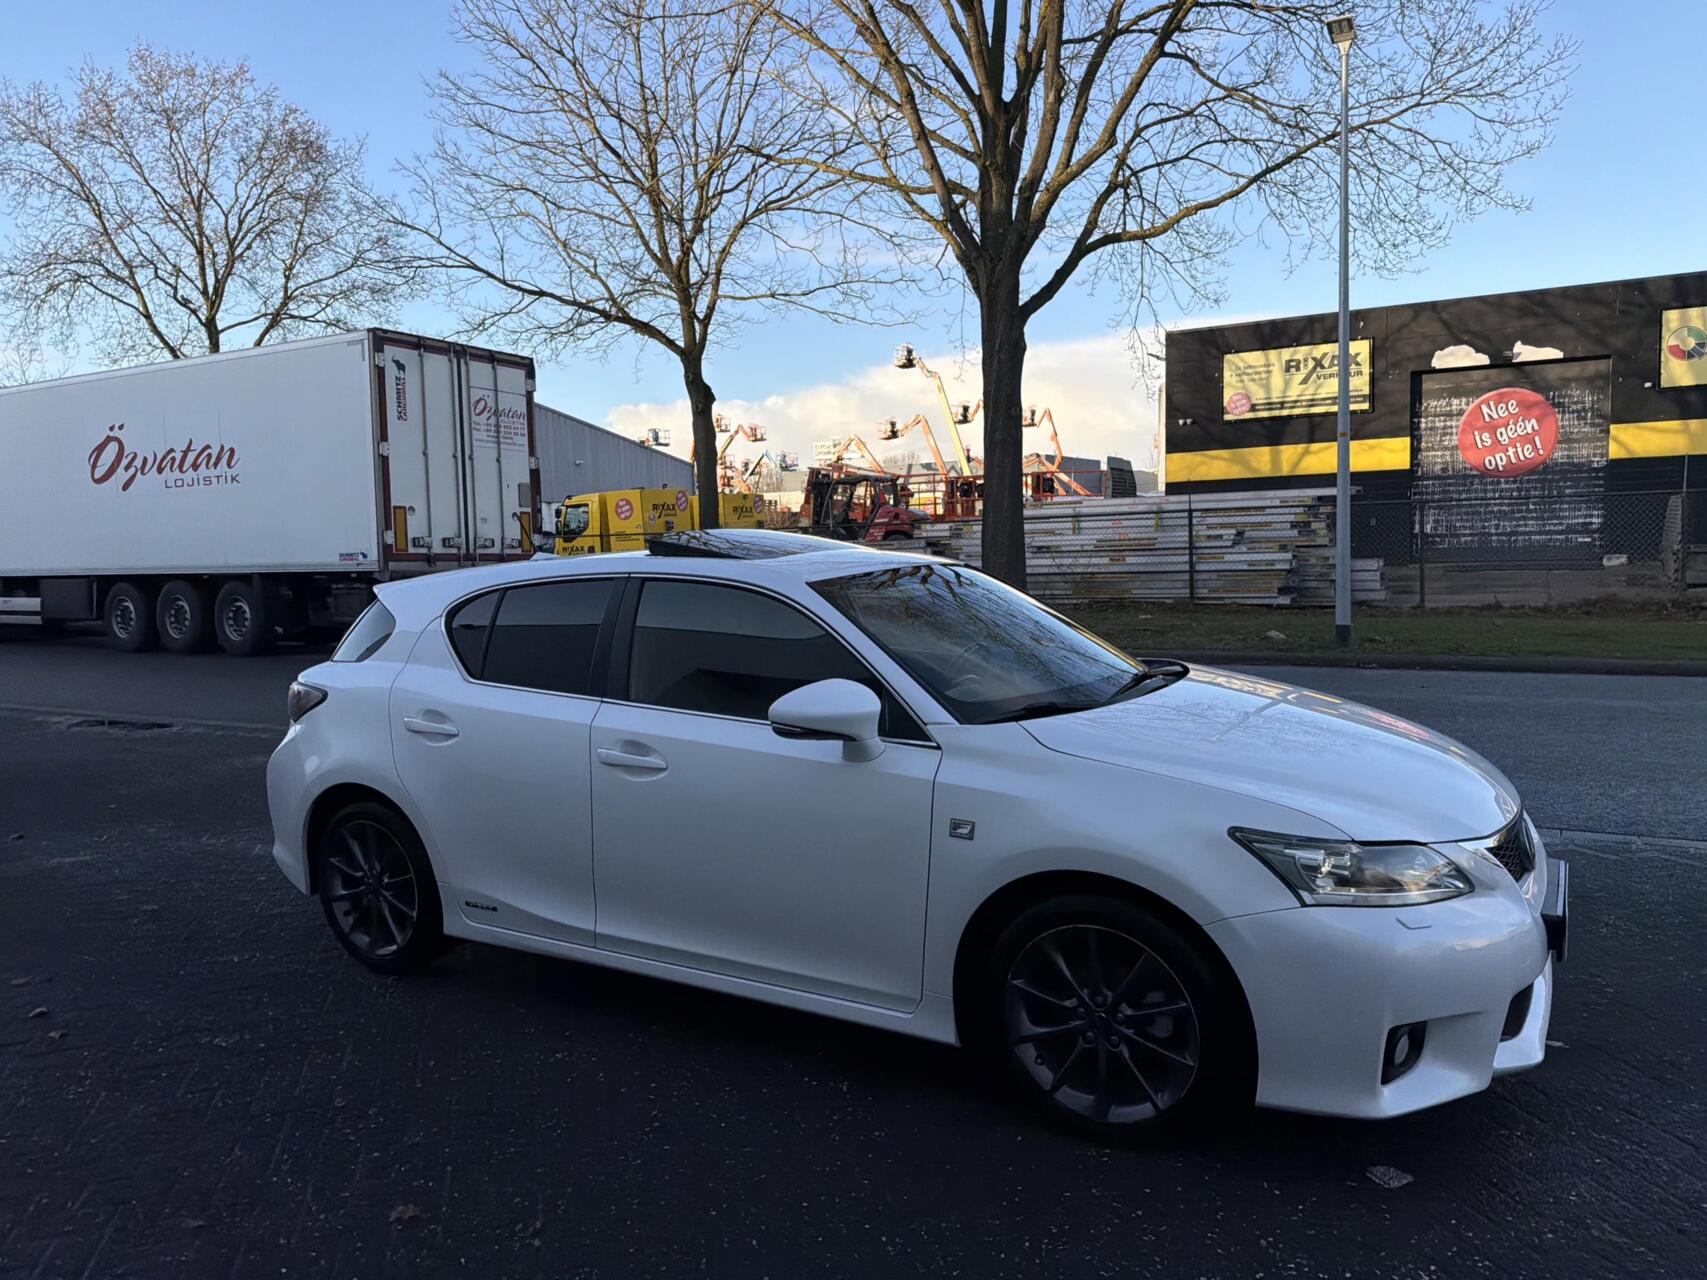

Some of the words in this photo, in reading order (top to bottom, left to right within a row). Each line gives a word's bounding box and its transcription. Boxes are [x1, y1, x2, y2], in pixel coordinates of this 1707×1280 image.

[1316, 370, 1363, 380] VERUR
[1480, 400, 1519, 422] Nee
[1473, 430, 1492, 449] is
[1496, 416, 1539, 445] géén
[88, 423, 240, 492] Özvatan
